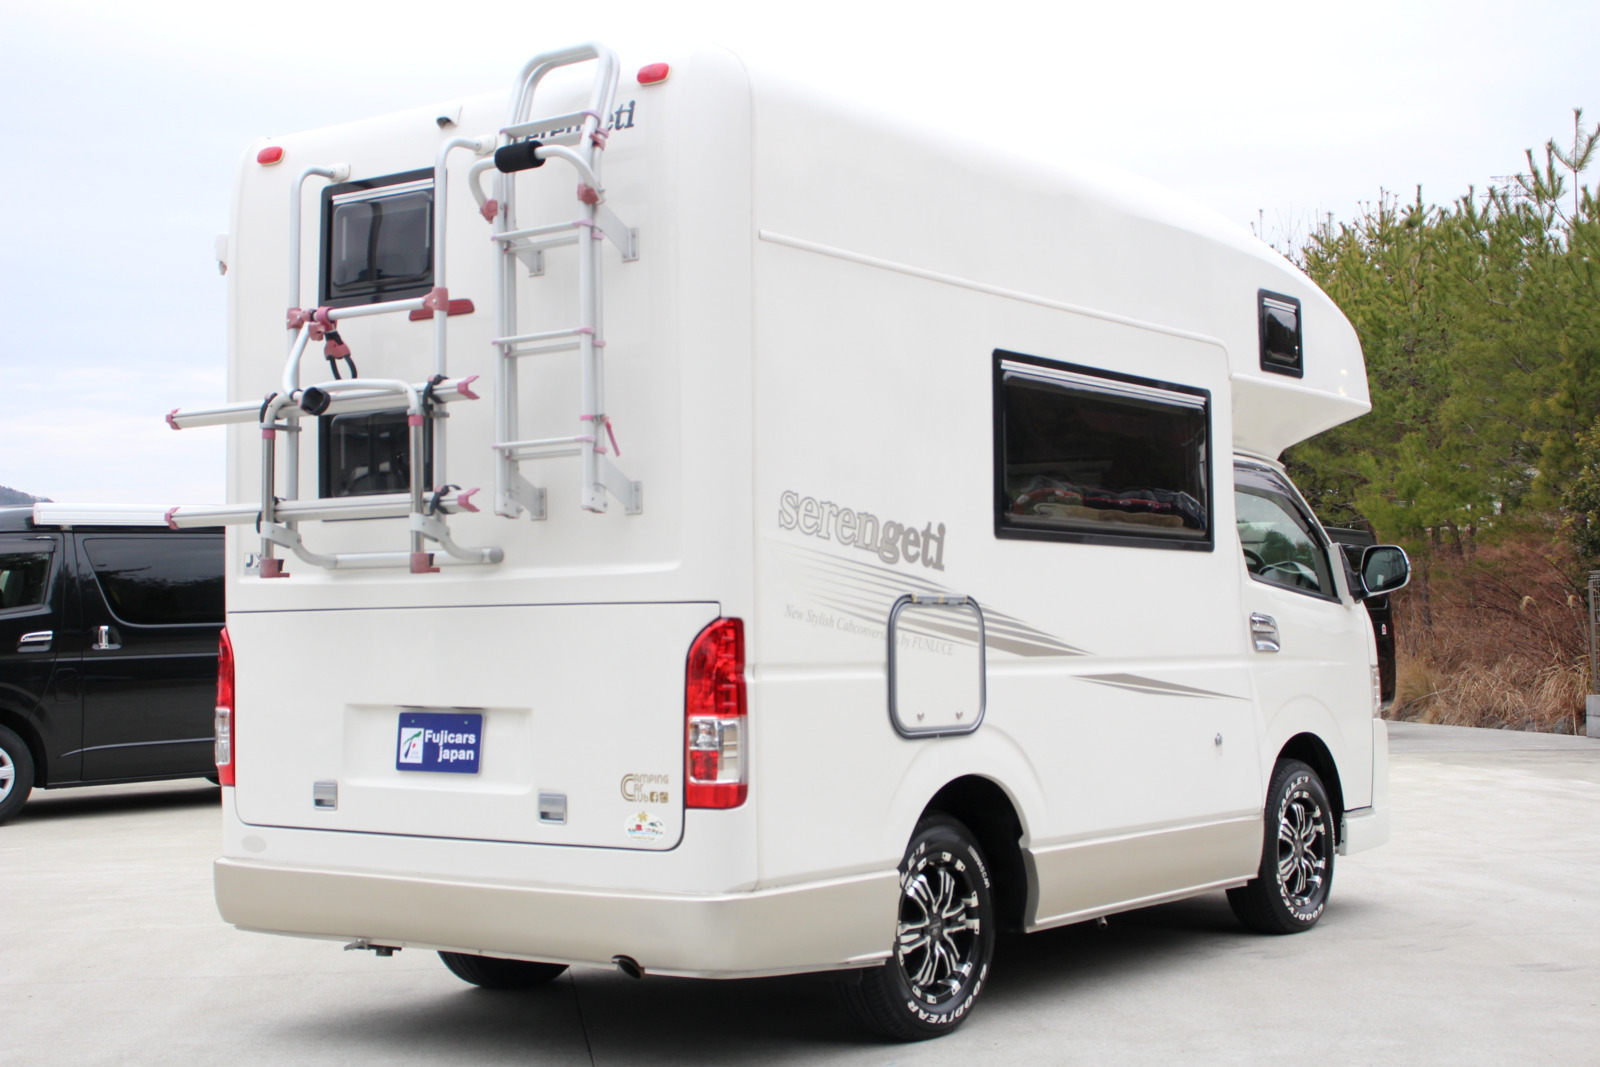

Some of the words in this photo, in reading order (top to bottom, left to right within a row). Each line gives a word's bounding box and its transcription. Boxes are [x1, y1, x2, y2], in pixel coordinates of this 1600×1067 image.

[784, 604, 805, 620] New
[806, 609, 835, 628] Stylish
[901, 634, 911, 650] by
[911, 634, 954, 656] FUNLUCE
[424, 729, 476, 746] Fujicars
[437, 746, 474, 763] japan
[907, 963, 987, 1024] GOODYEAR
